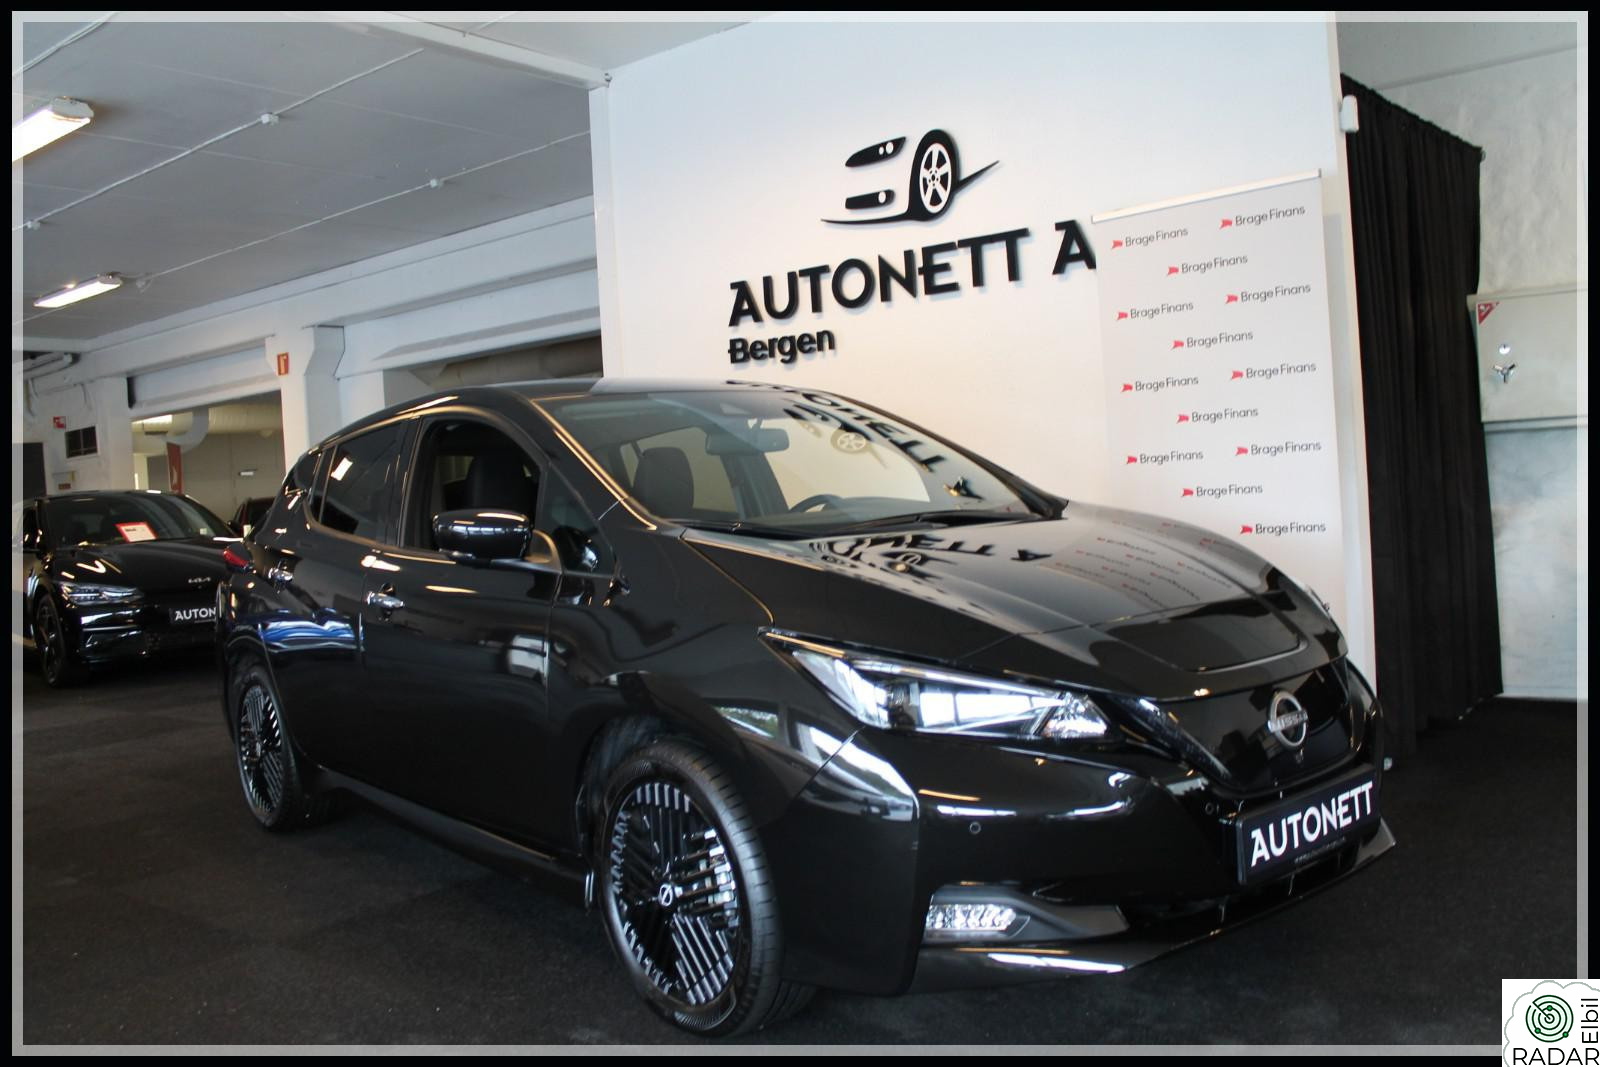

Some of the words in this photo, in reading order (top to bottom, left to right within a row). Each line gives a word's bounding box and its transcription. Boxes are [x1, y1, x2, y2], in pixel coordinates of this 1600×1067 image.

[1235, 213, 1269, 227] Brage
[1269, 206, 1306, 221] Finans
[1124, 234, 1155, 248] Brage
[1155, 228, 1189, 241] Finans
[1181, 261, 1213, 275] Brage
[1213, 255, 1249, 269] Finans
[729, 228, 1030, 327] AUTONETT
[1240, 290, 1274, 303] Brage
[1274, 284, 1312, 297] Finans
[1129, 307, 1161, 320] Brage
[1160, 302, 1194, 314] Finans
[728, 329, 835, 364] Bergen
[1186, 336, 1219, 349] Brage
[1218, 331, 1254, 344] Finans
[1245, 367, 1280, 380] Brage
[1280, 363, 1317, 375] Finans
[1134, 380, 1166, 393] Brage
[1165, 376, 1199, 388] Finans
[1191, 411, 1223, 424] Brage
[1223, 407, 1259, 420] Finans
[1139, 453, 1170, 466] Brage
[1170, 450, 1204, 462] Finans
[1250, 443, 1284, 457] Brage
[1284, 441, 1322, 454] Finans
[1195, 485, 1228, 499] Brage
[1228, 483, 1264, 495] Finans
[1255, 522, 1289, 537] Brage
[1289, 521, 1327, 533] Finans
[1251, 781, 1373, 867] AUTONETT
